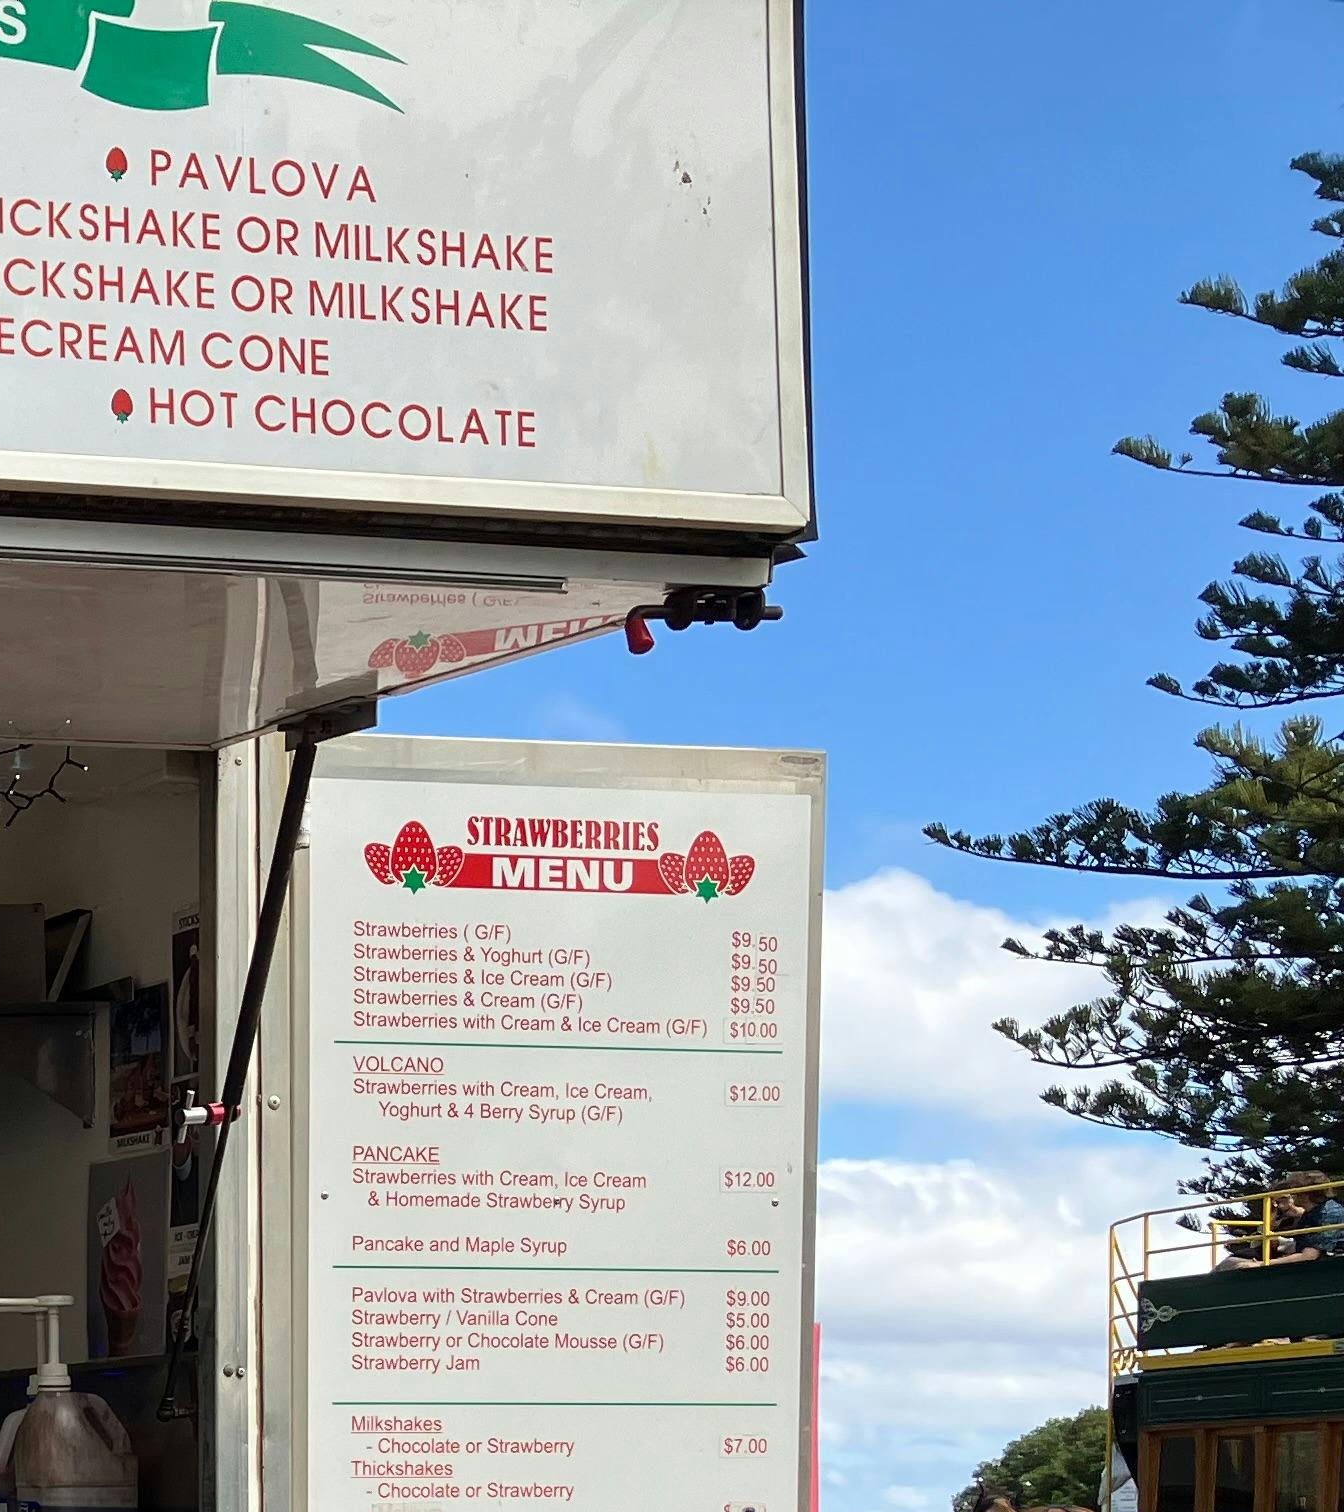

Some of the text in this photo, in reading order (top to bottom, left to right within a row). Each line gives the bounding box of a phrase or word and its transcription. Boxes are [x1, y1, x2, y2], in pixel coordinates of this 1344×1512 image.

[150, 148, 376, 202] PAVLOVA
[236, 215, 300, 256] OR
[315, 221, 554, 274] MILKSHAKE
[231, 274, 294, 316] OR
[309, 280, 547, 332] MILKSHAKE
[201, 331, 329, 377] CONE
[149, 388, 536, 448] HOT CHOCOLATE
[467, 816, 660, 851] STRAWBERRIES
[492, 856, 634, 892] MENU
[352, 1286, 771, 1309] Pavlova with Strawberries & Cream (G/F) $9.00
[351, 1415, 444, 1435] Milkshakes
[377, 1438, 462, 1456] Chocolate
[466, 1441, 481, 1455] or
[486, 1438, 576, 1458] Strawberry
[723, 1438, 769, 1456] $7.00
